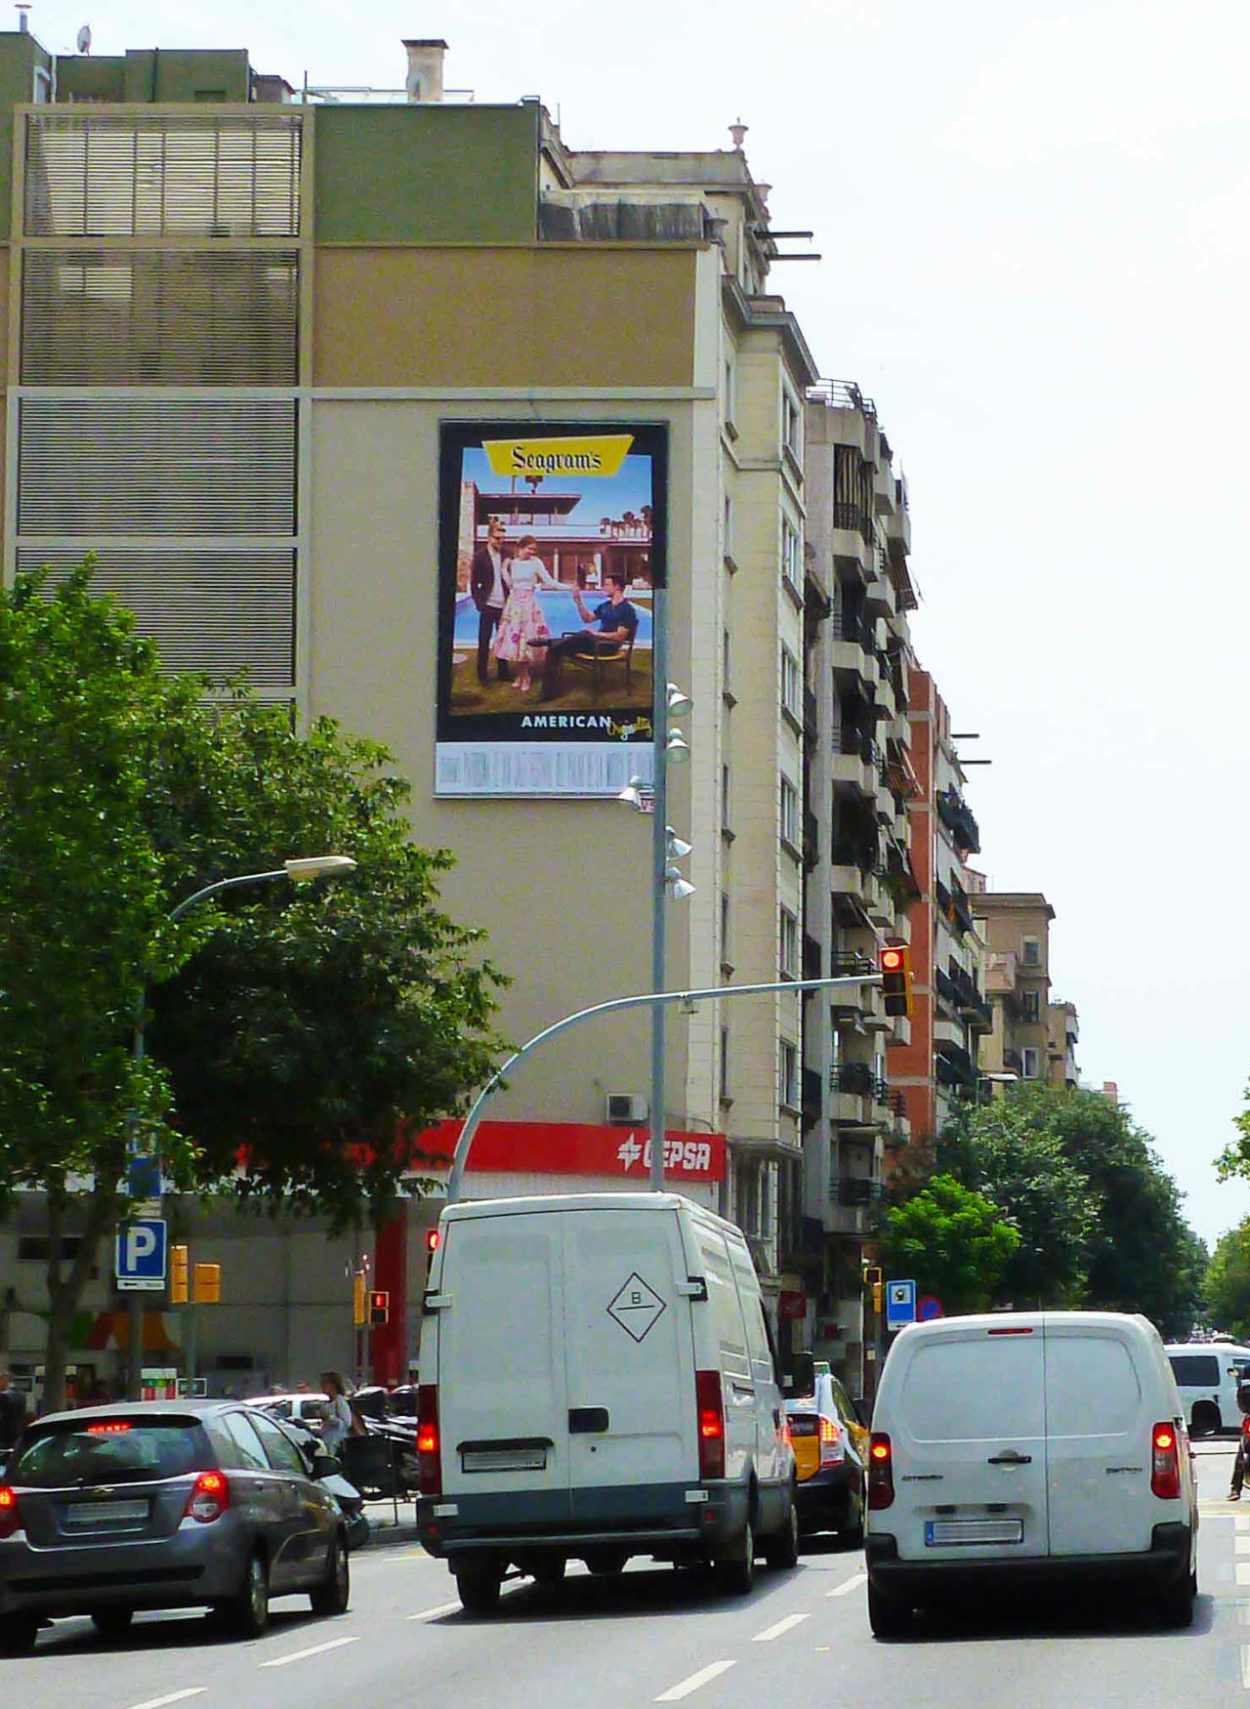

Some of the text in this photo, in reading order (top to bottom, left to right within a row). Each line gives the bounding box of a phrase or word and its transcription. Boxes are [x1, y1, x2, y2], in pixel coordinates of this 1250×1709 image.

[511, 446, 603, 474] Seagram's
[521, 715, 612, 728] AMERICAN
[126, 1226, 157, 1272] P
[631, 1291, 642, 1305] B
